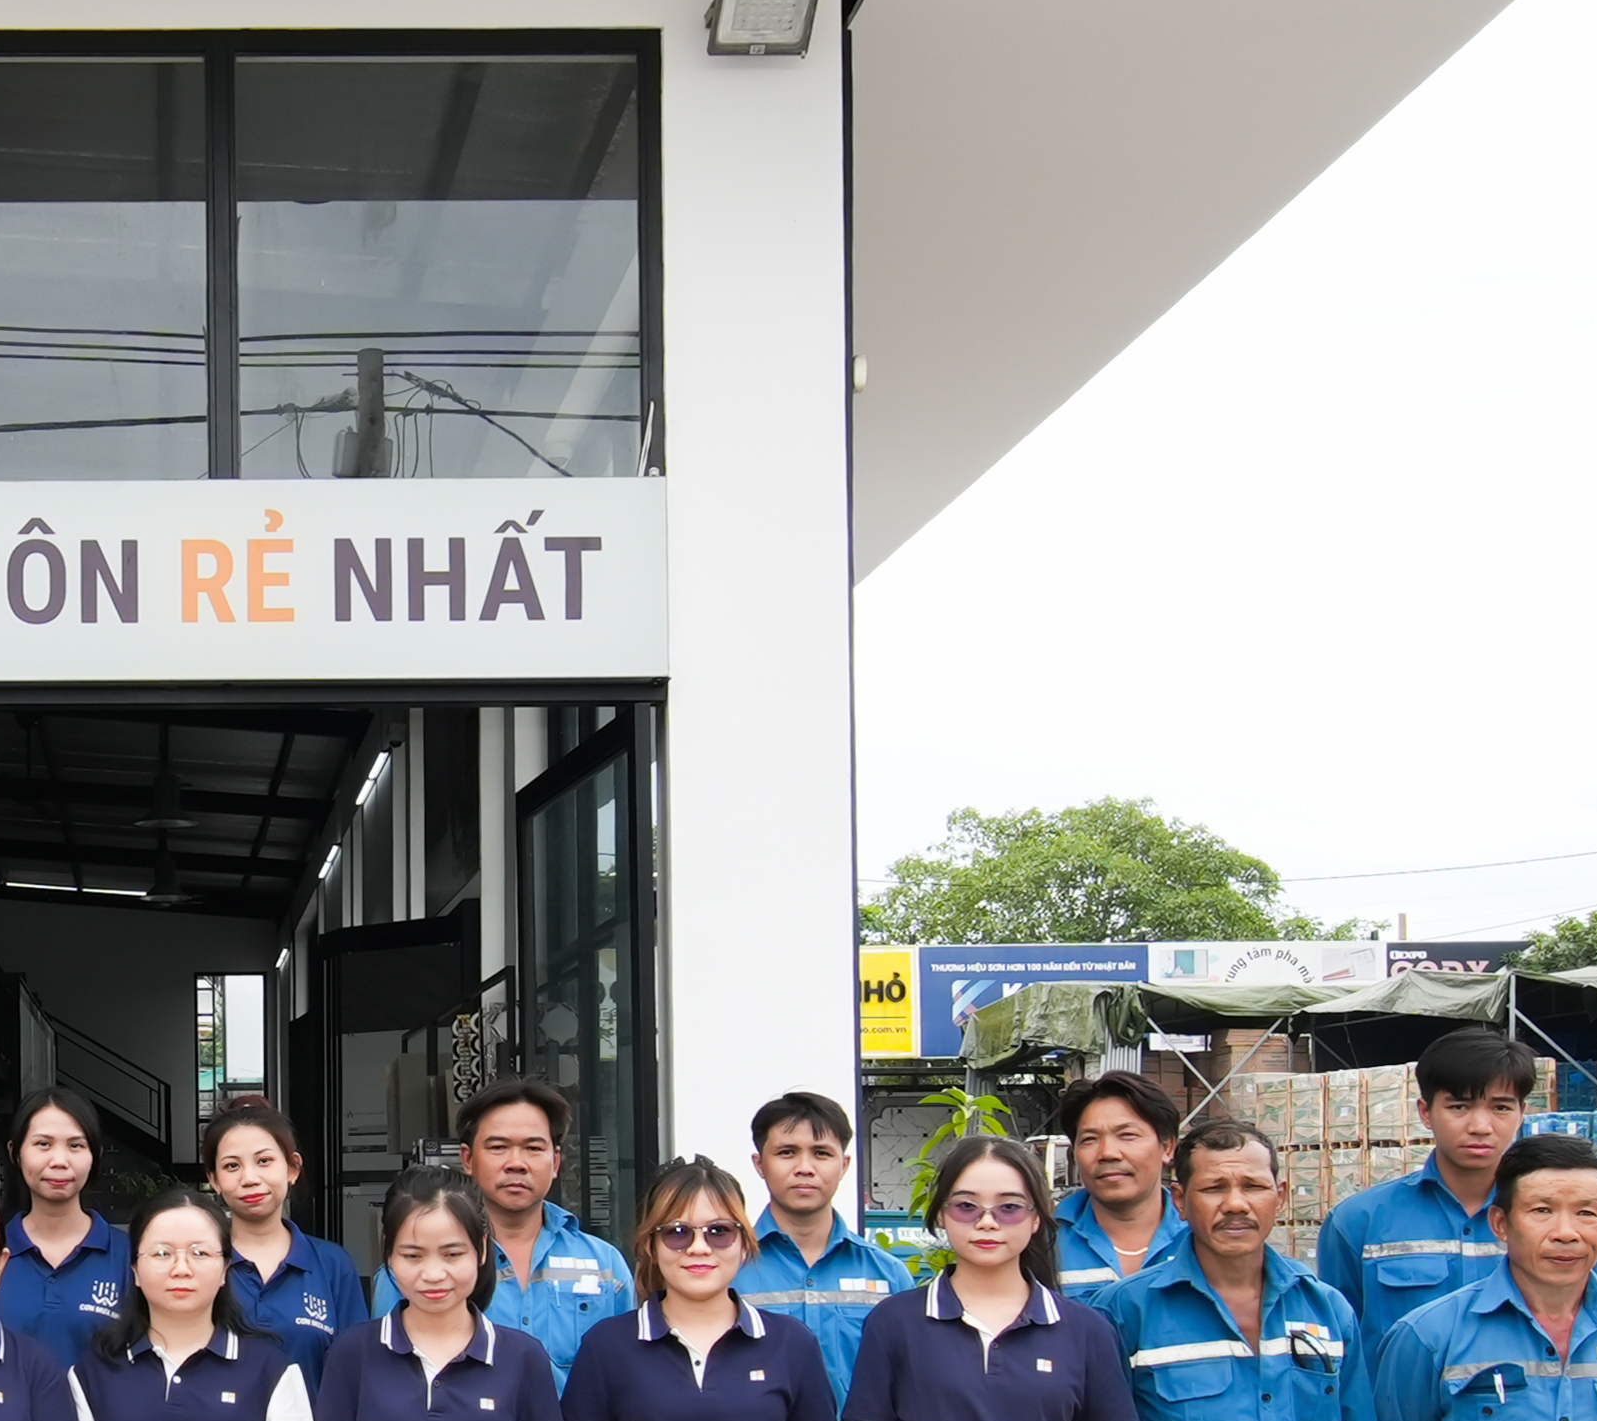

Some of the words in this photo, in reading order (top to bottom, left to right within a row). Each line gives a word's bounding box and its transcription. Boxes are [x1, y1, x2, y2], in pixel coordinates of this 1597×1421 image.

[179, 508, 297, 624] RẺ
[334, 508, 604, 623] NHẤT
[1027, 963, 1042, 971] 100
[1224, 957, 1248, 983] rung
[1274, 949, 1299, 966] pha
[860, 971, 906, 1003] HỎ
[861, 1026, 907, 1034] o.com.vn
